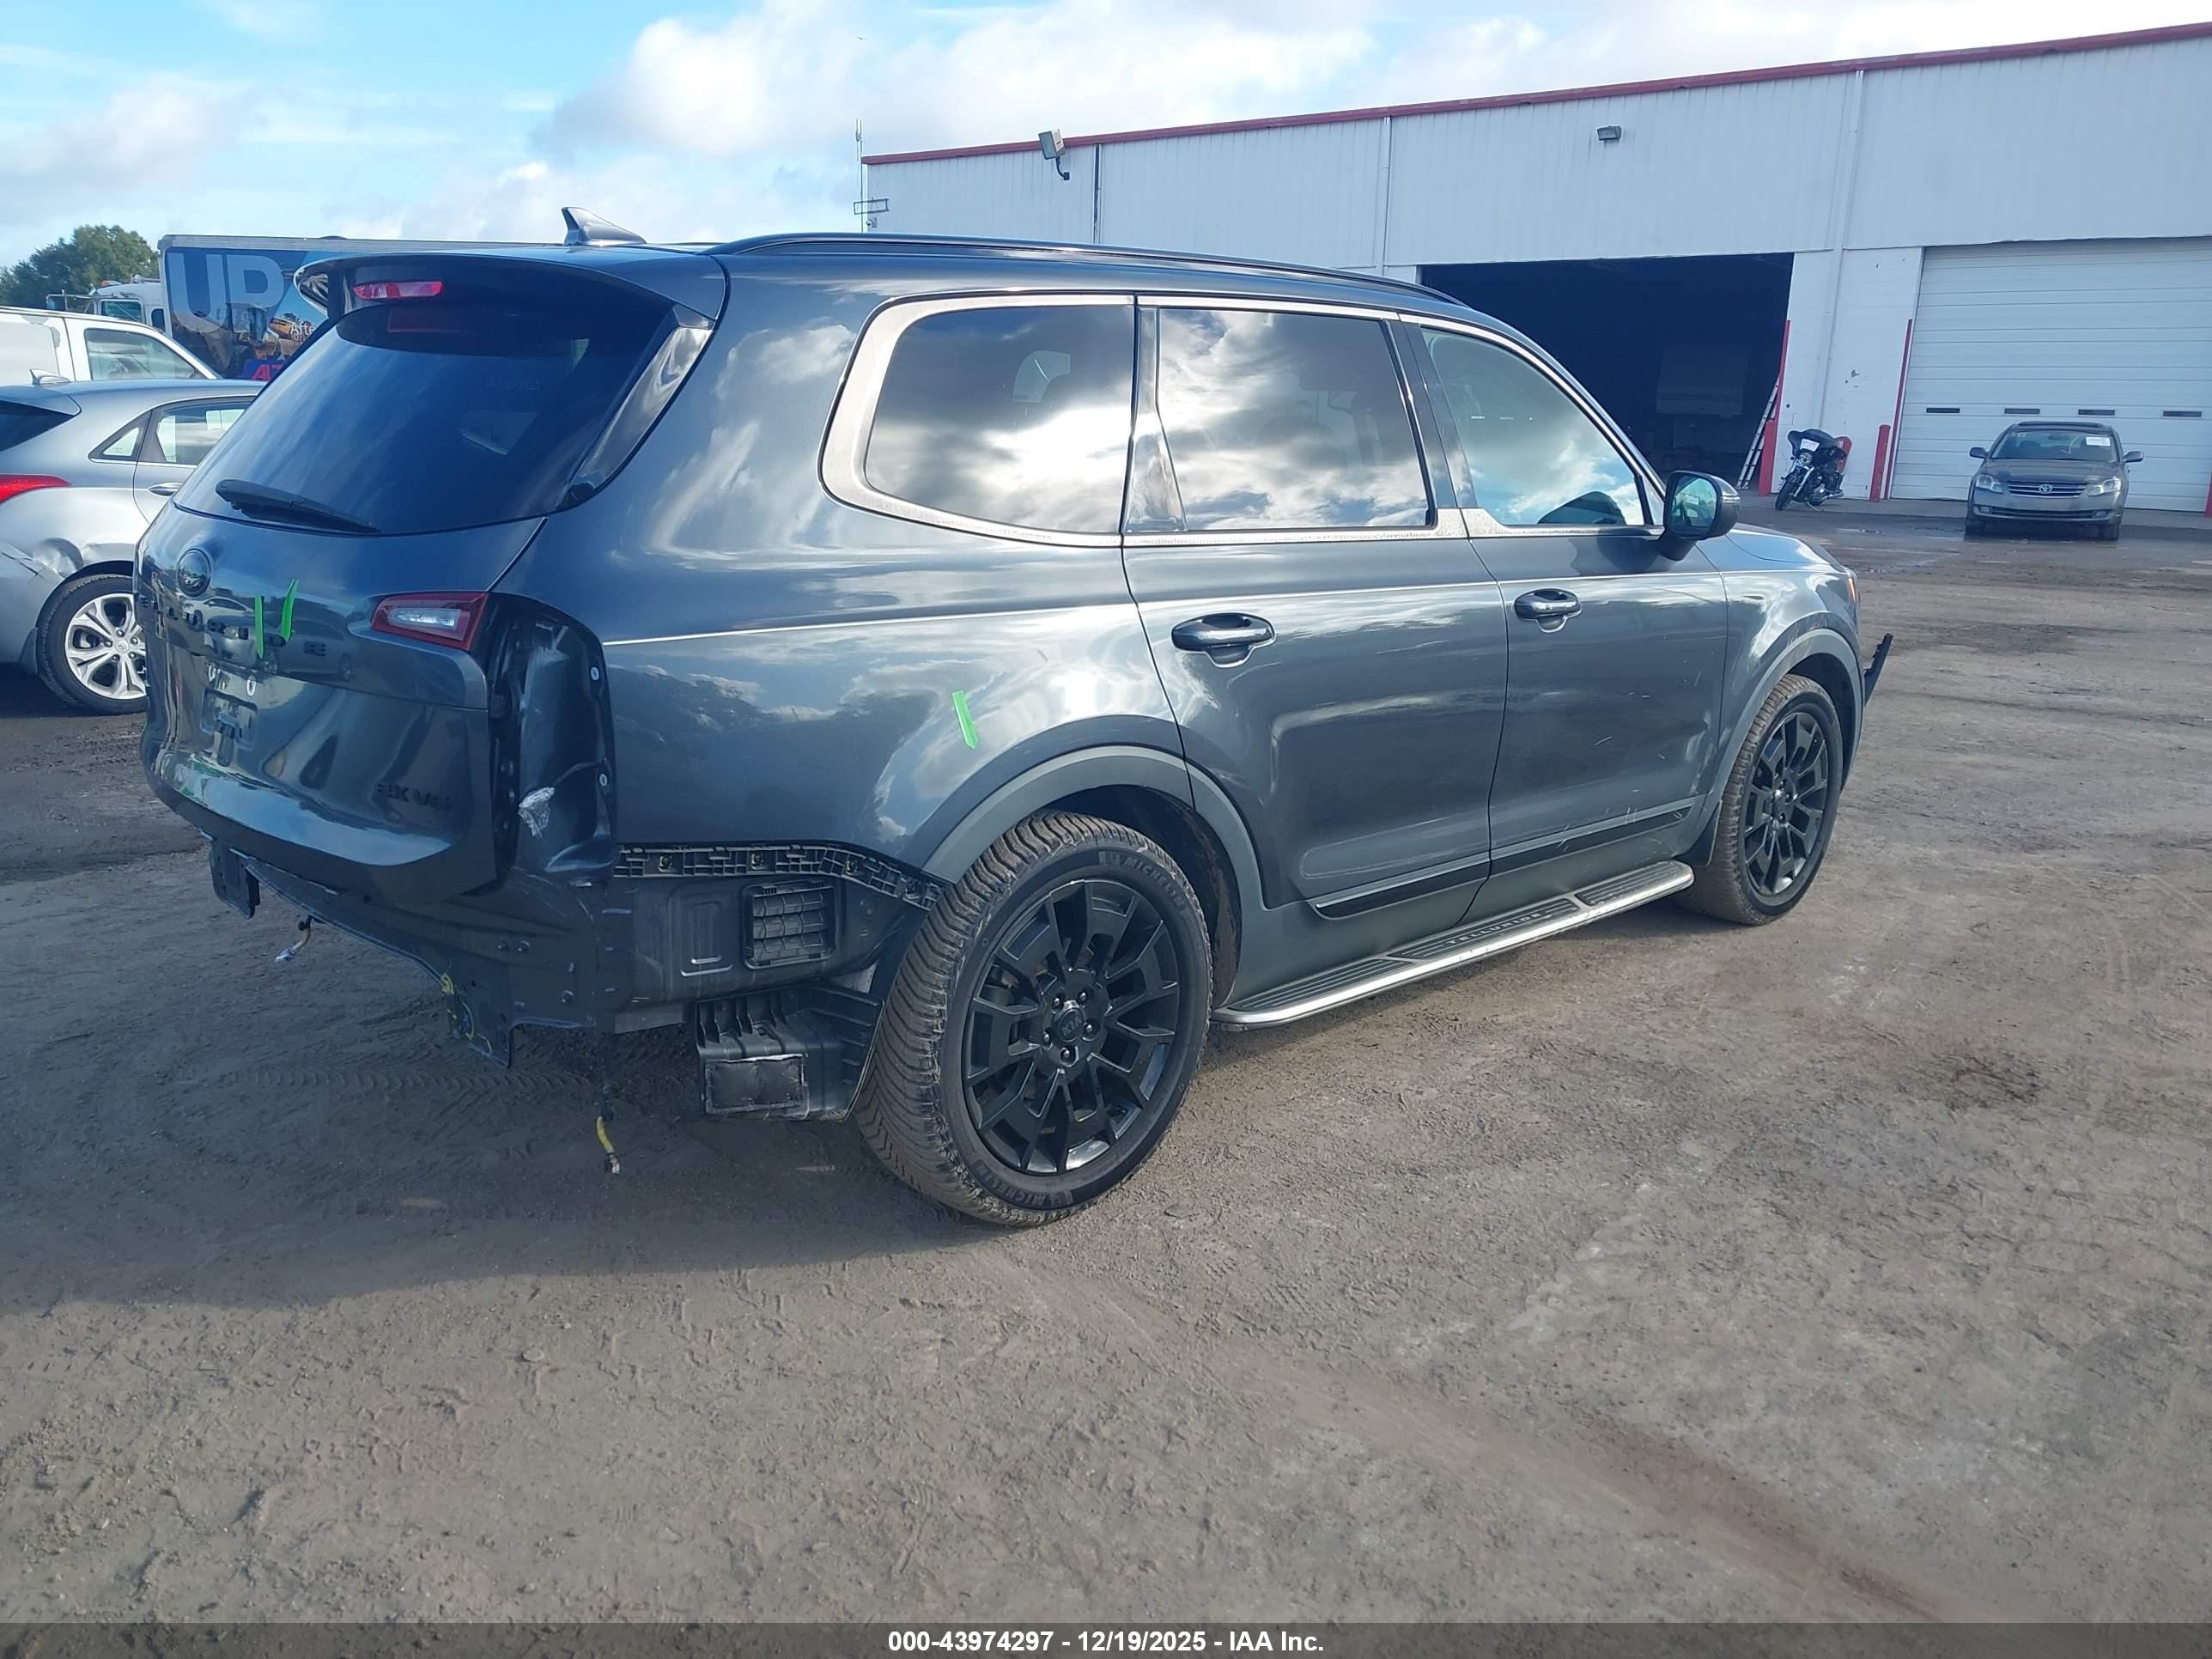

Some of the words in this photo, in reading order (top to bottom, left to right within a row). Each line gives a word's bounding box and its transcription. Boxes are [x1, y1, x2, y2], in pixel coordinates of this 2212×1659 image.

[167, 252, 285, 334] UP
[1122, 855, 1186, 908] MICHELIN
[975, 1165, 1047, 1206] MICHELIN
